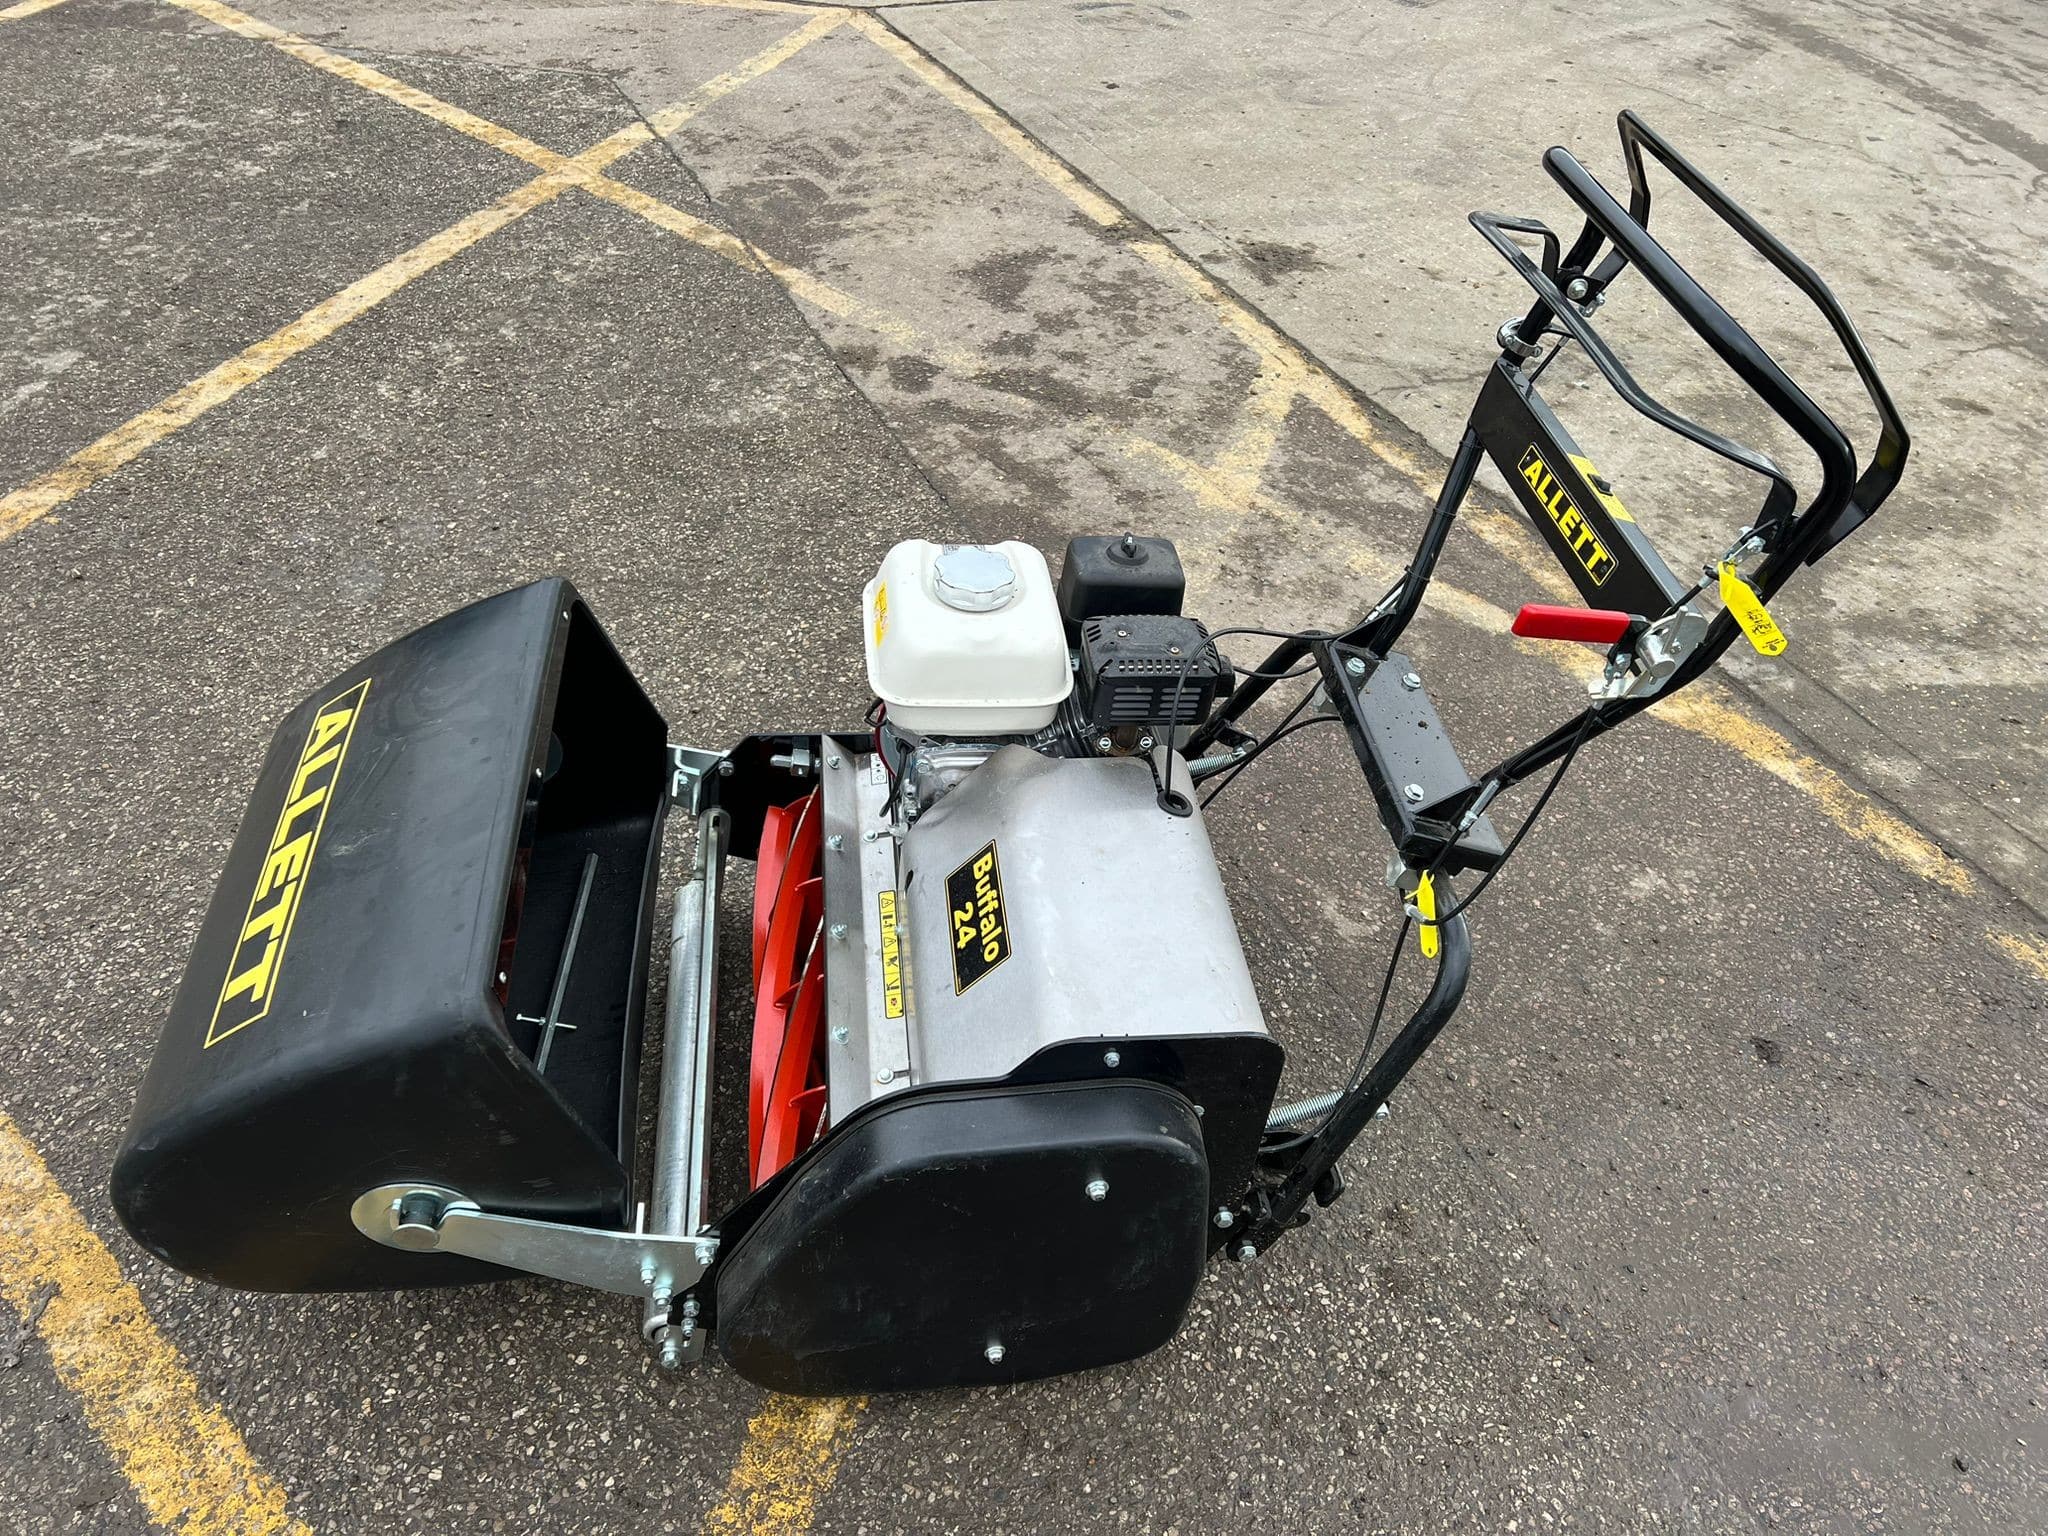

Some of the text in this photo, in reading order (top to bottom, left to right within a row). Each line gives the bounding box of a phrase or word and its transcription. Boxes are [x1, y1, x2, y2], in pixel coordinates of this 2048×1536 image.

[1524, 459, 1608, 571] ALLETT
[223, 708, 354, 1003] ALLETT
[973, 852, 1003, 963] Buffalo
[953, 901, 977, 950] 24
